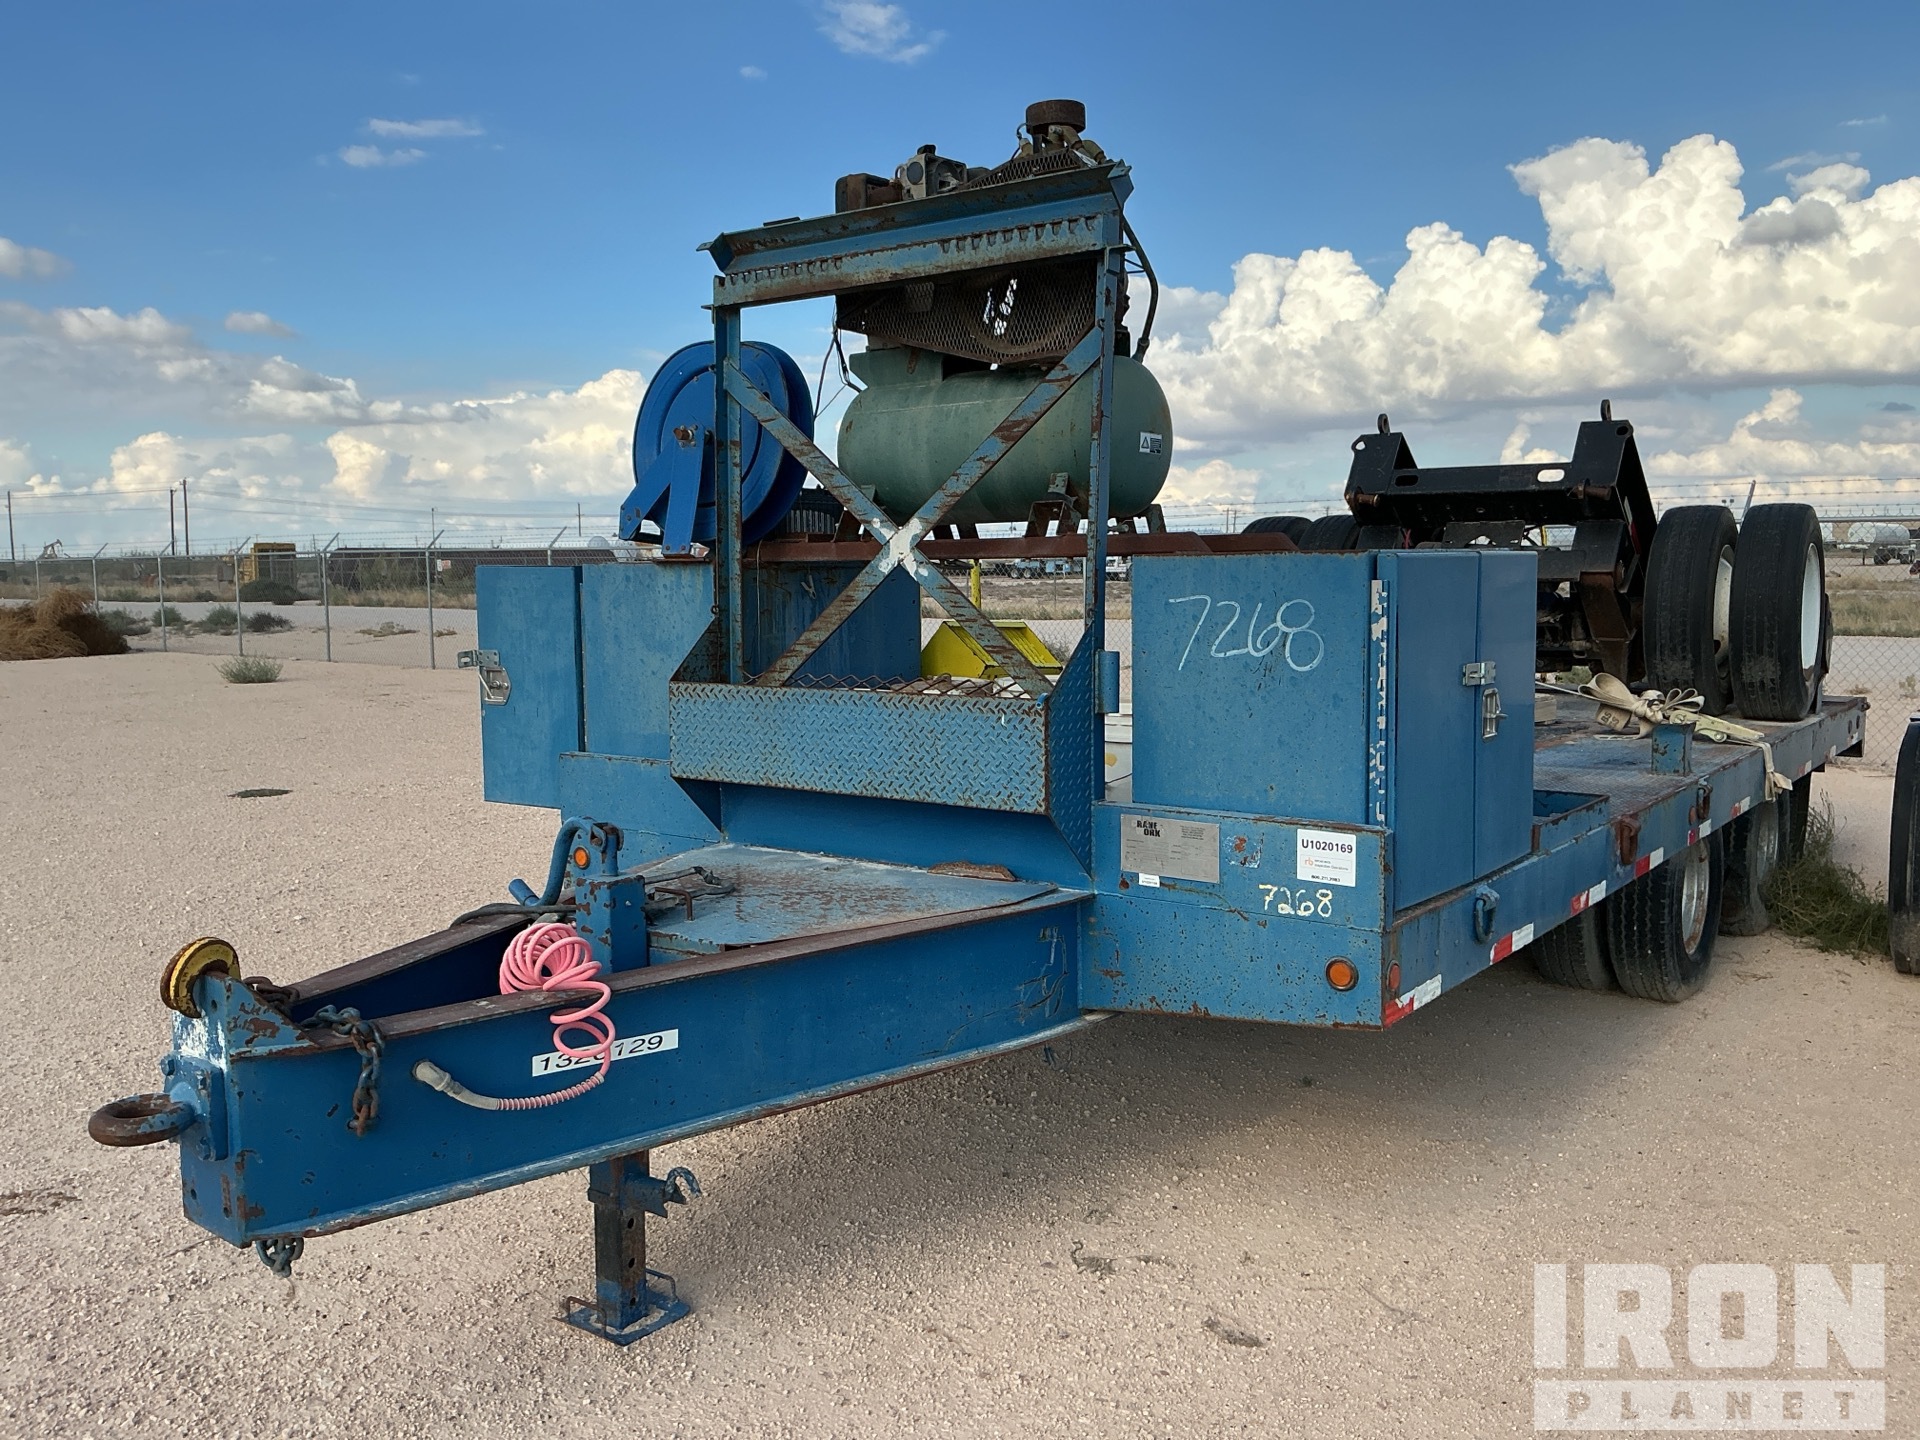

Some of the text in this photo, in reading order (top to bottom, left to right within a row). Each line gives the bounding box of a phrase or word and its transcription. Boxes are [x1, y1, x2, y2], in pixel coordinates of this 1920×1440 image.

[1168, 594, 1325, 672] 7268
[1301, 838, 1353, 854] U1020169
[1258, 884, 1333, 918] 7268
[540, 1035, 664, 1071] 132129
